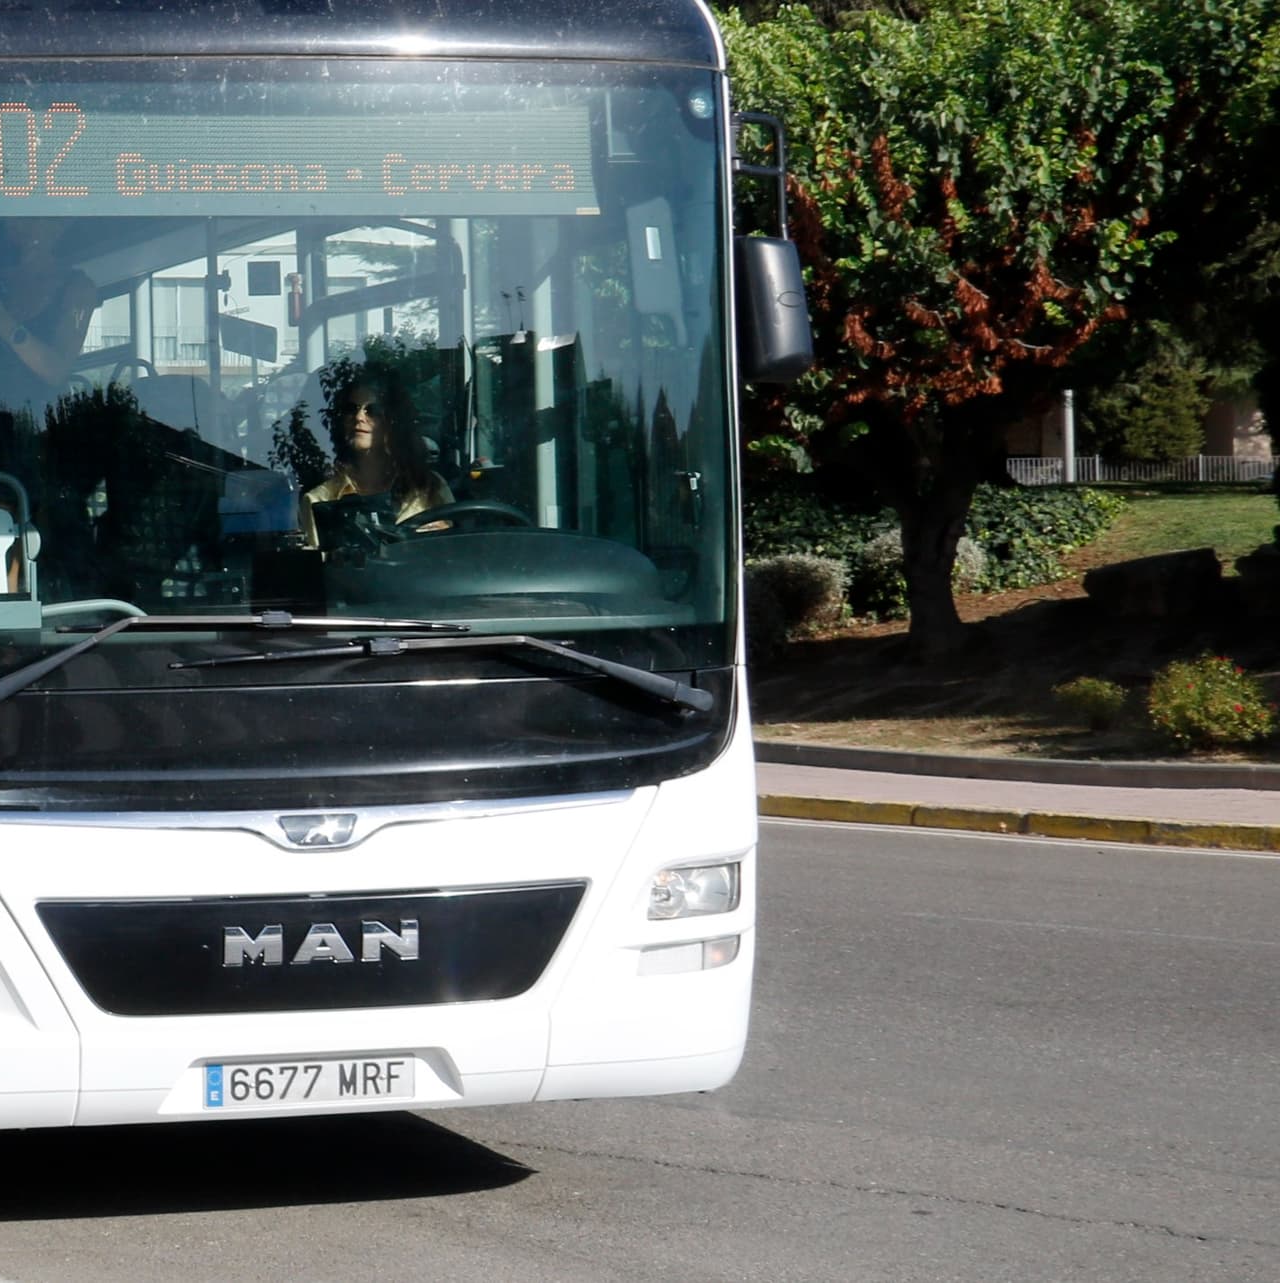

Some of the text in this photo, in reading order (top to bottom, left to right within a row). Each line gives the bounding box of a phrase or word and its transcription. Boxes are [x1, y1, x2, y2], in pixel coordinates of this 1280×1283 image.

[116, 152, 327, 196] Guissona
[382, 152, 575, 196] Cervera
[222, 919, 420, 967] MAN
[209, 1090, 220, 1101] E
[230, 1061, 405, 1101] 6677 MRF
